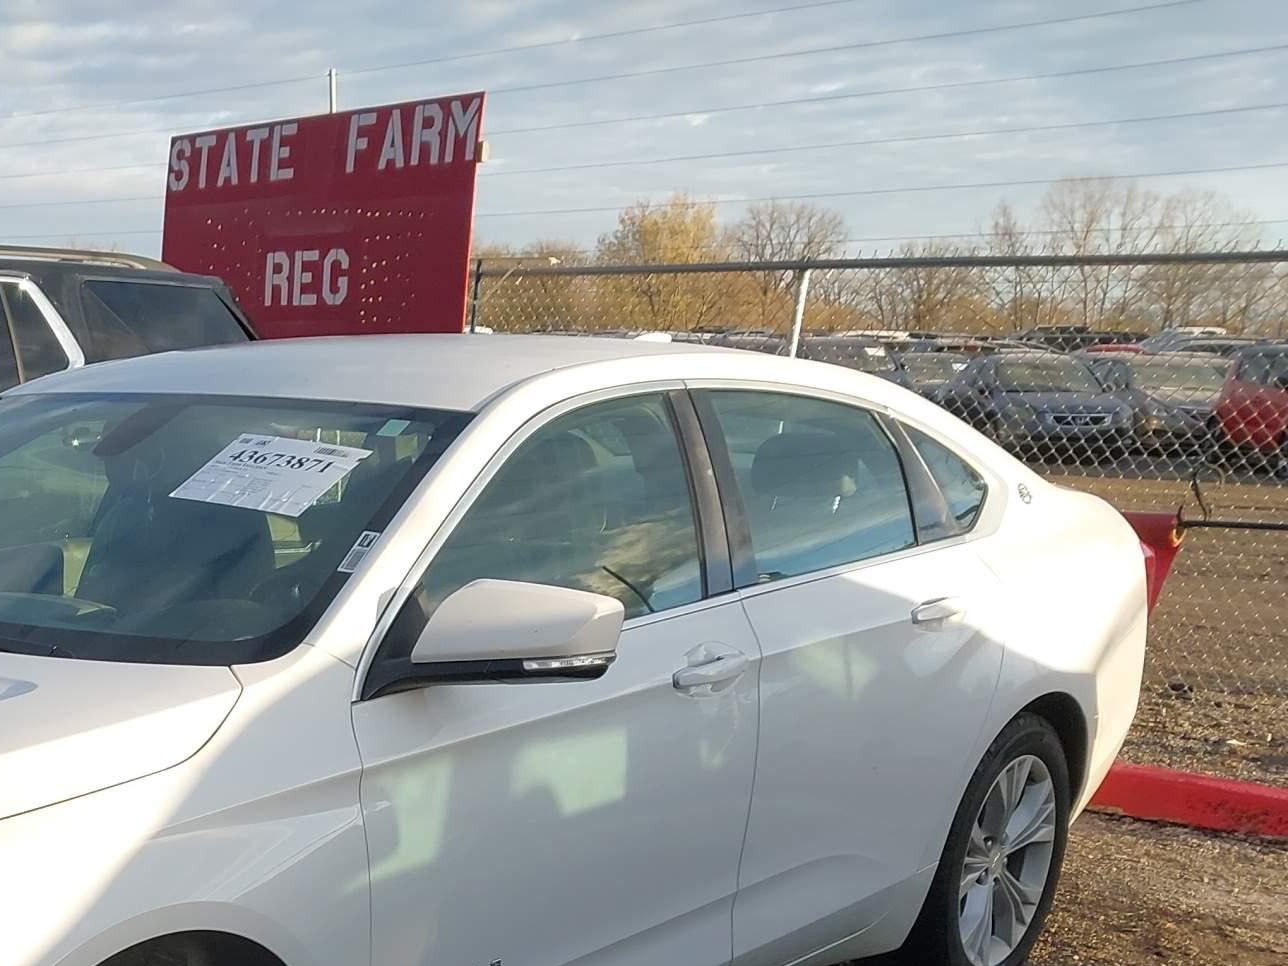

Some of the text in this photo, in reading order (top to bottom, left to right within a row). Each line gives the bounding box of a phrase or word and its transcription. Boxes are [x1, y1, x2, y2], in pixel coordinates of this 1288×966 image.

[168, 97, 481, 193] STATE FARM
[264, 248, 350, 307] REG
[229, 448, 335, 473] 43673871
